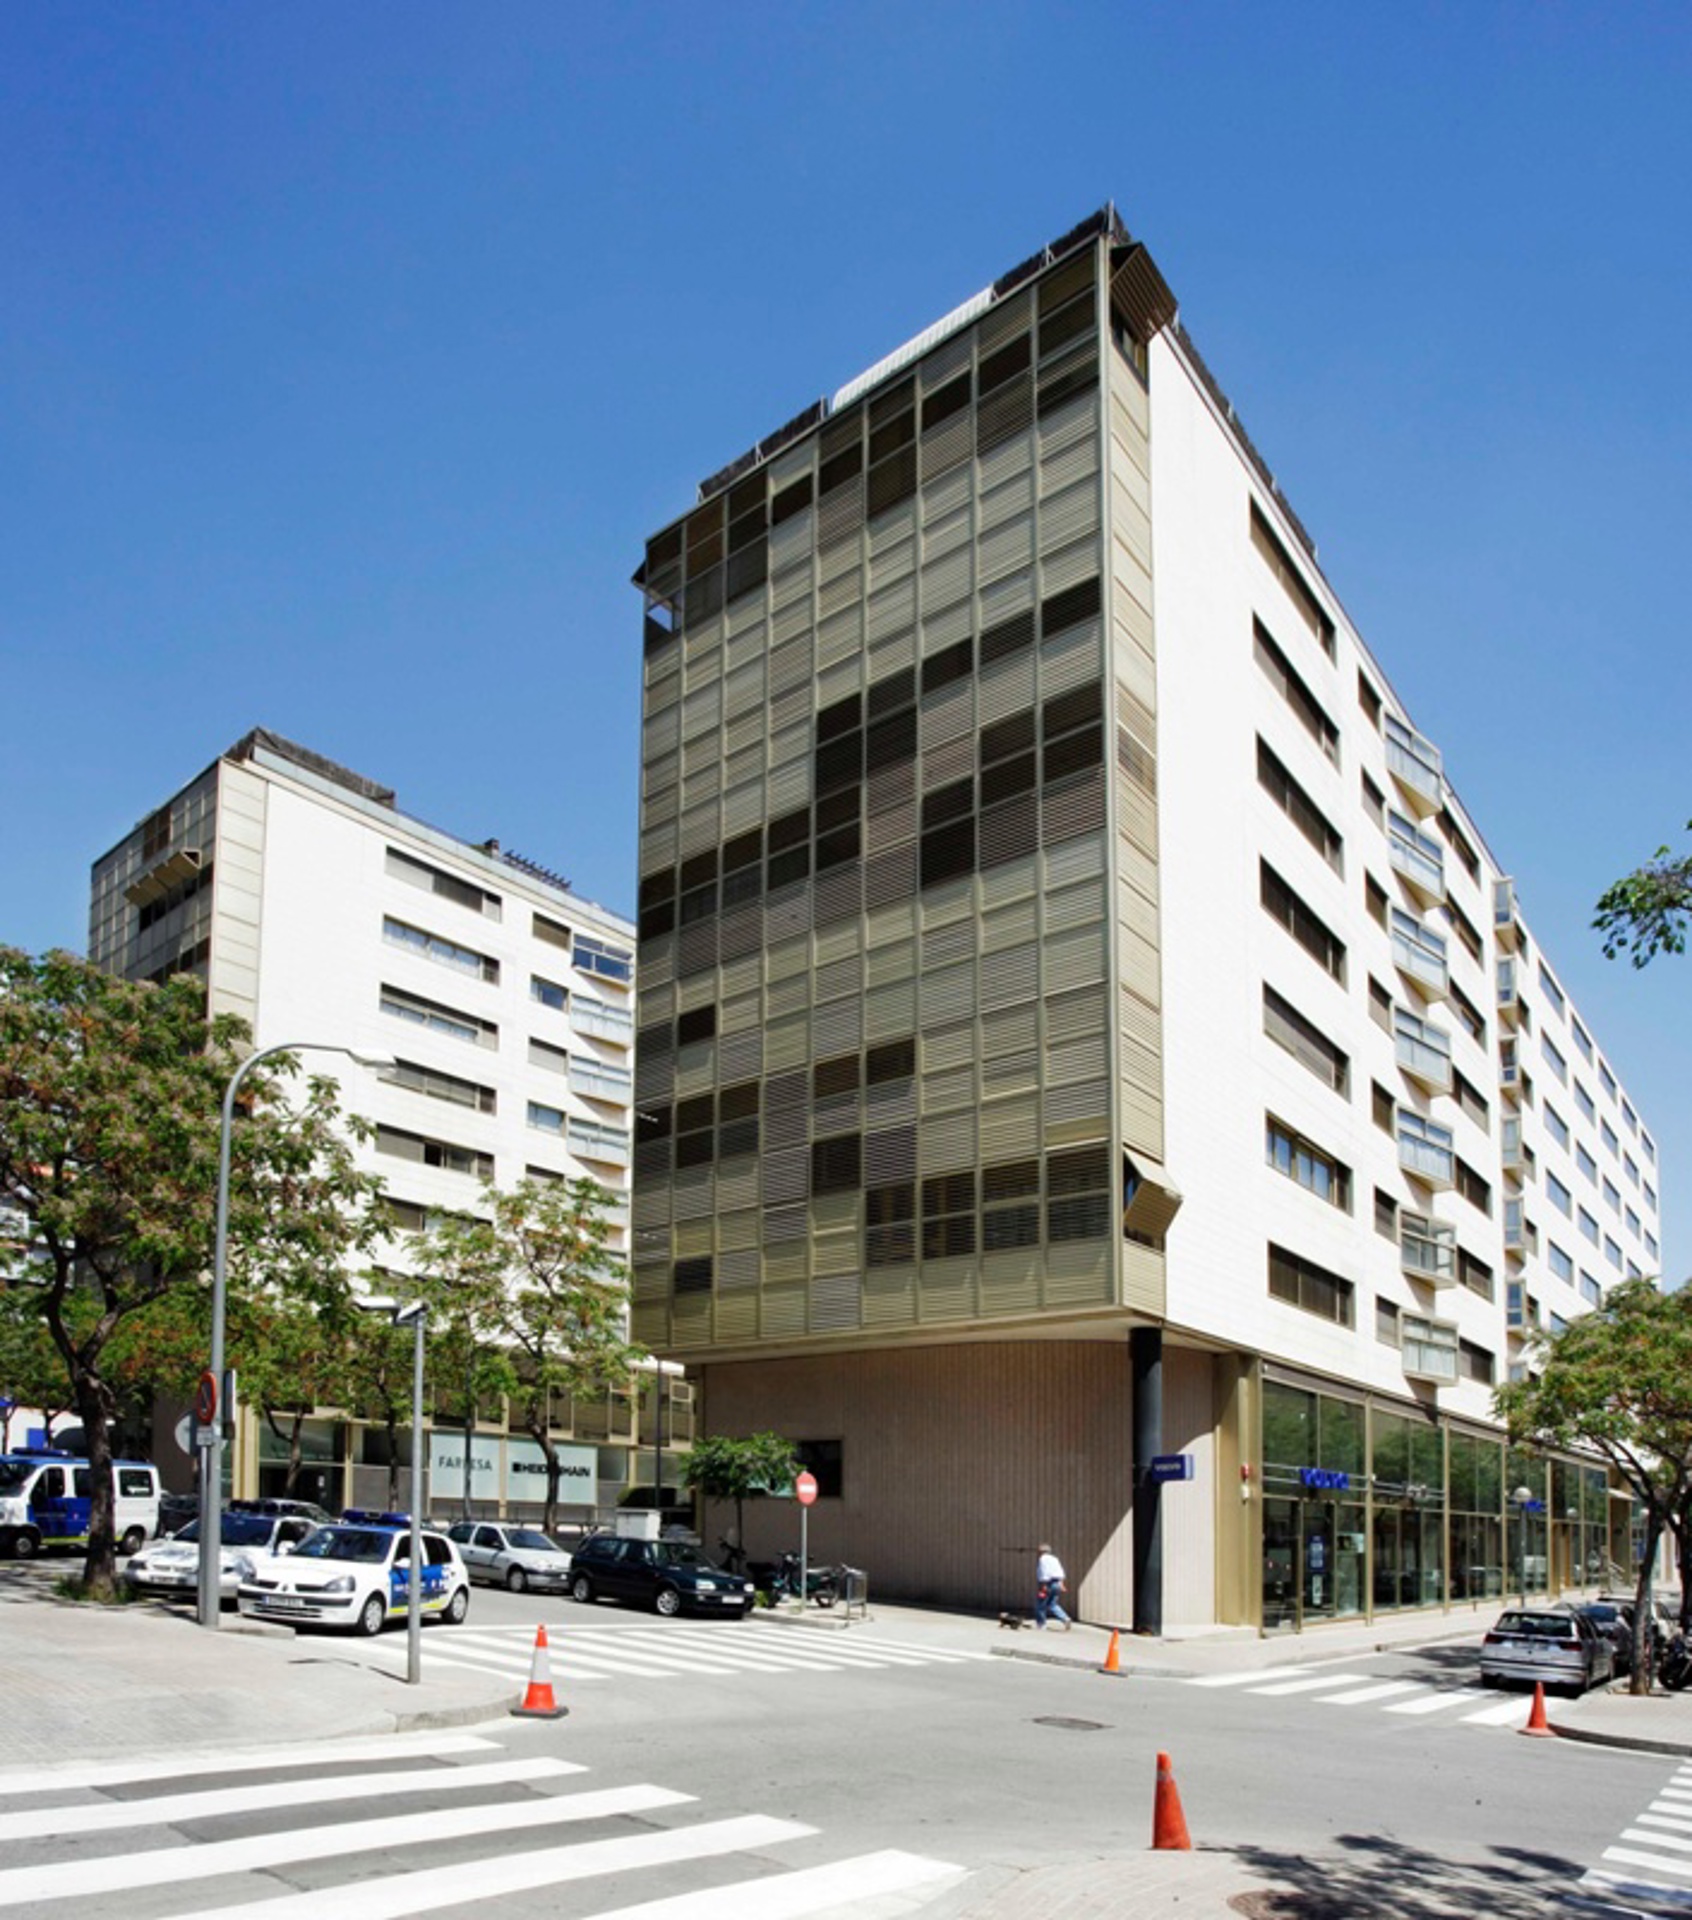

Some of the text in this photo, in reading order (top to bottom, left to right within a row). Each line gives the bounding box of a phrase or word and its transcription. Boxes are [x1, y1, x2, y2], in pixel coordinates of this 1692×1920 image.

[438, 1456, 493, 1471] FARESA
[522, 1462, 591, 1477] HEIDHAIN
[1299, 1468, 1349, 1489] VOLVO
